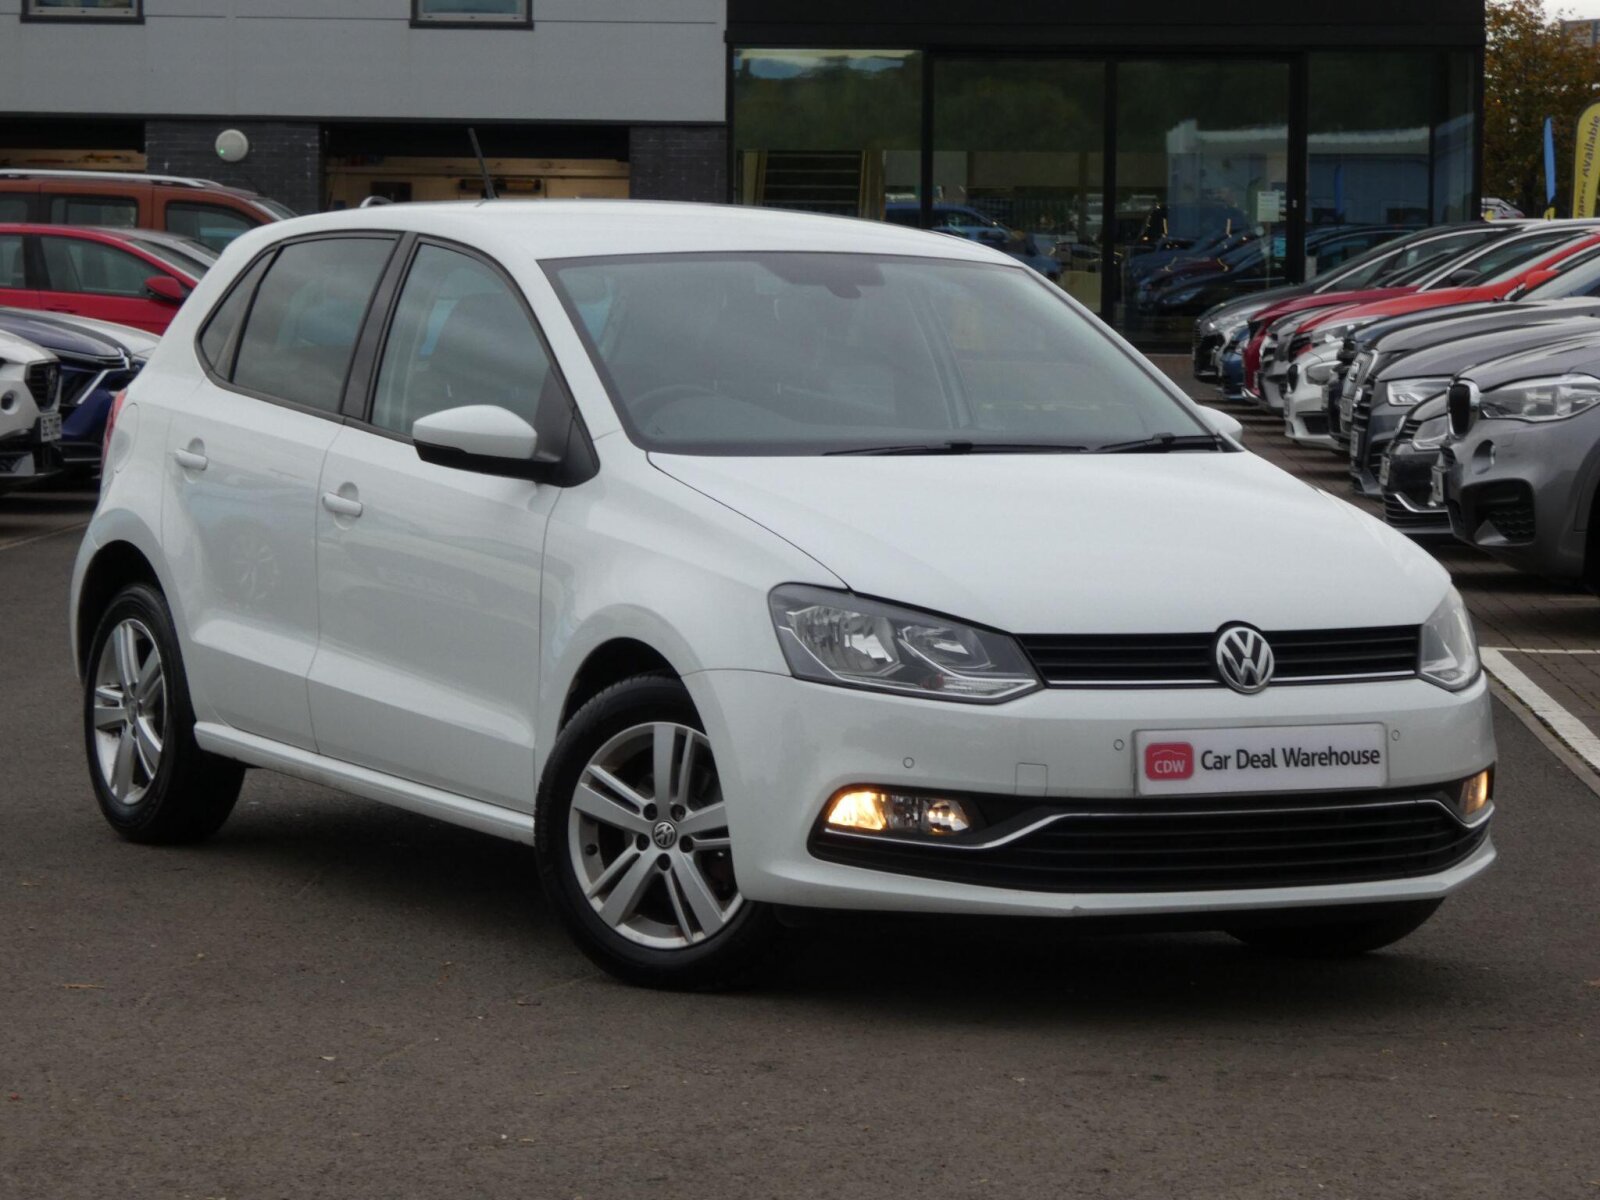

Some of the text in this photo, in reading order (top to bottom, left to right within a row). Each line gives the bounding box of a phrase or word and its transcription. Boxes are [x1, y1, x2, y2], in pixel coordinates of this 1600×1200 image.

[1583, 115, 1600, 177] Available
[1154, 759, 1185, 774] CDW
[1201, 746, 1380, 771] Car Deal Warehouse
